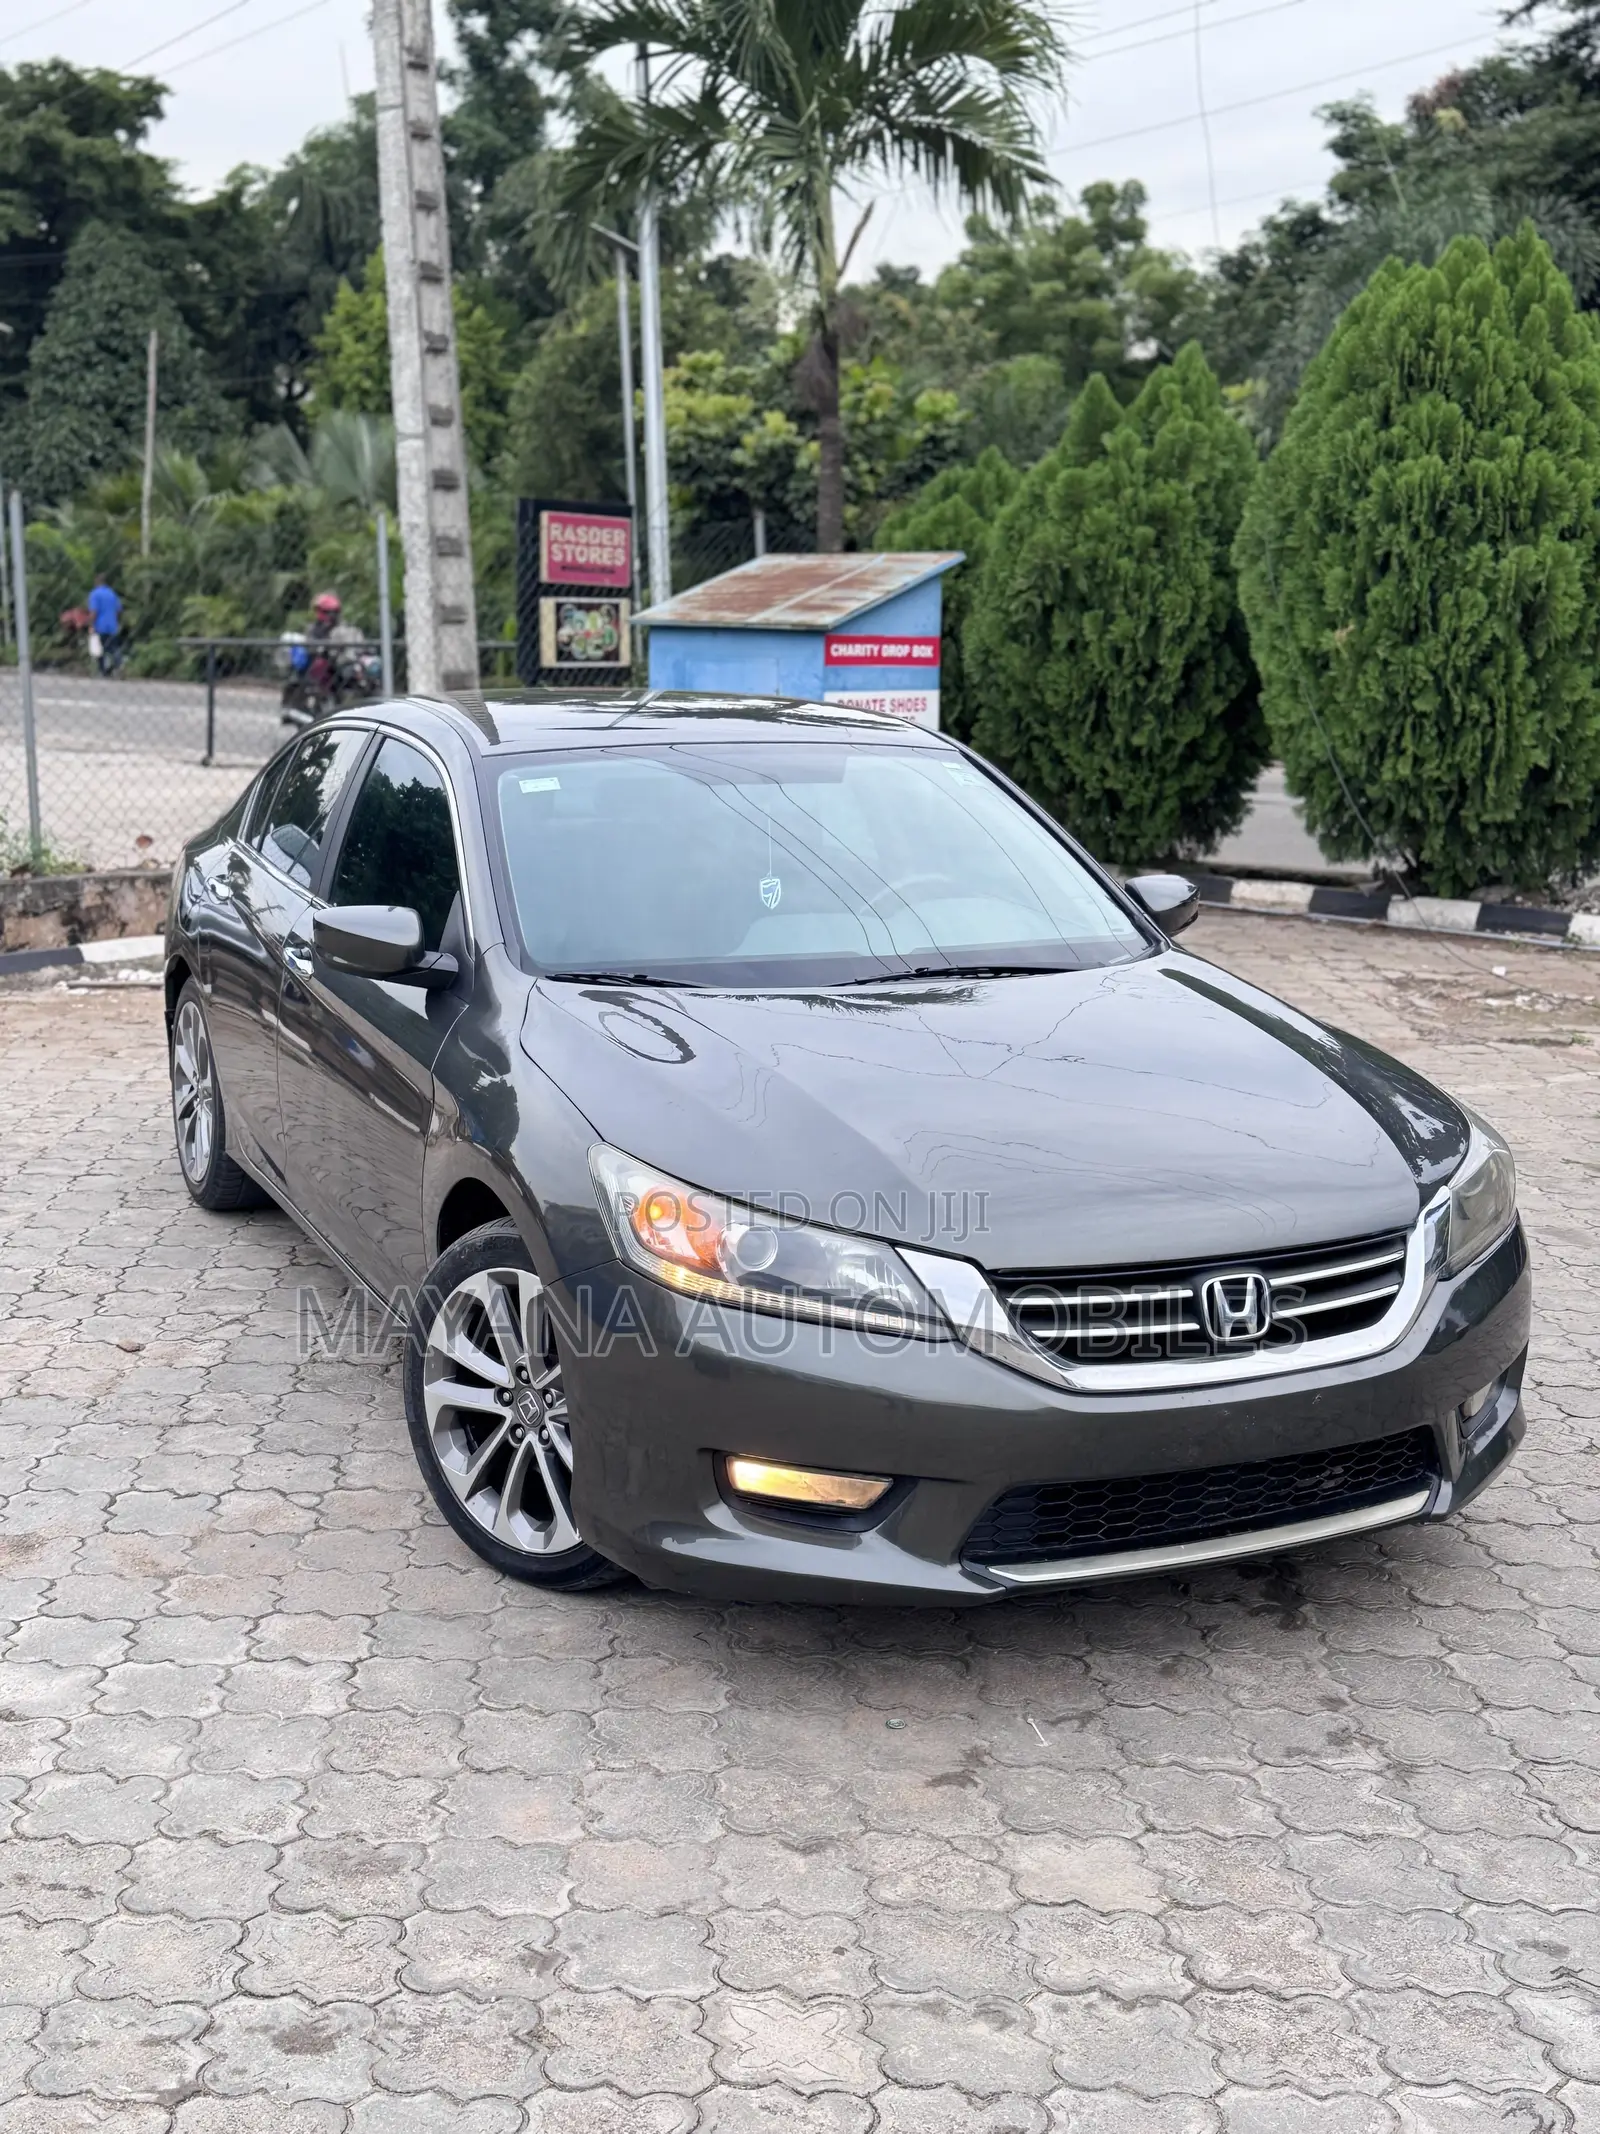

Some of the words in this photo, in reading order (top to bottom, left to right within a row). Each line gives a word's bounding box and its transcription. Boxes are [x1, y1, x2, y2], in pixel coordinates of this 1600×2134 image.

[550, 543, 626, 567] STORES
[830, 643, 880, 658] CHARITY
[881, 644, 910, 658] DROP
[912, 645, 934, 658] BOX
[889, 697, 927, 713] SHOES
